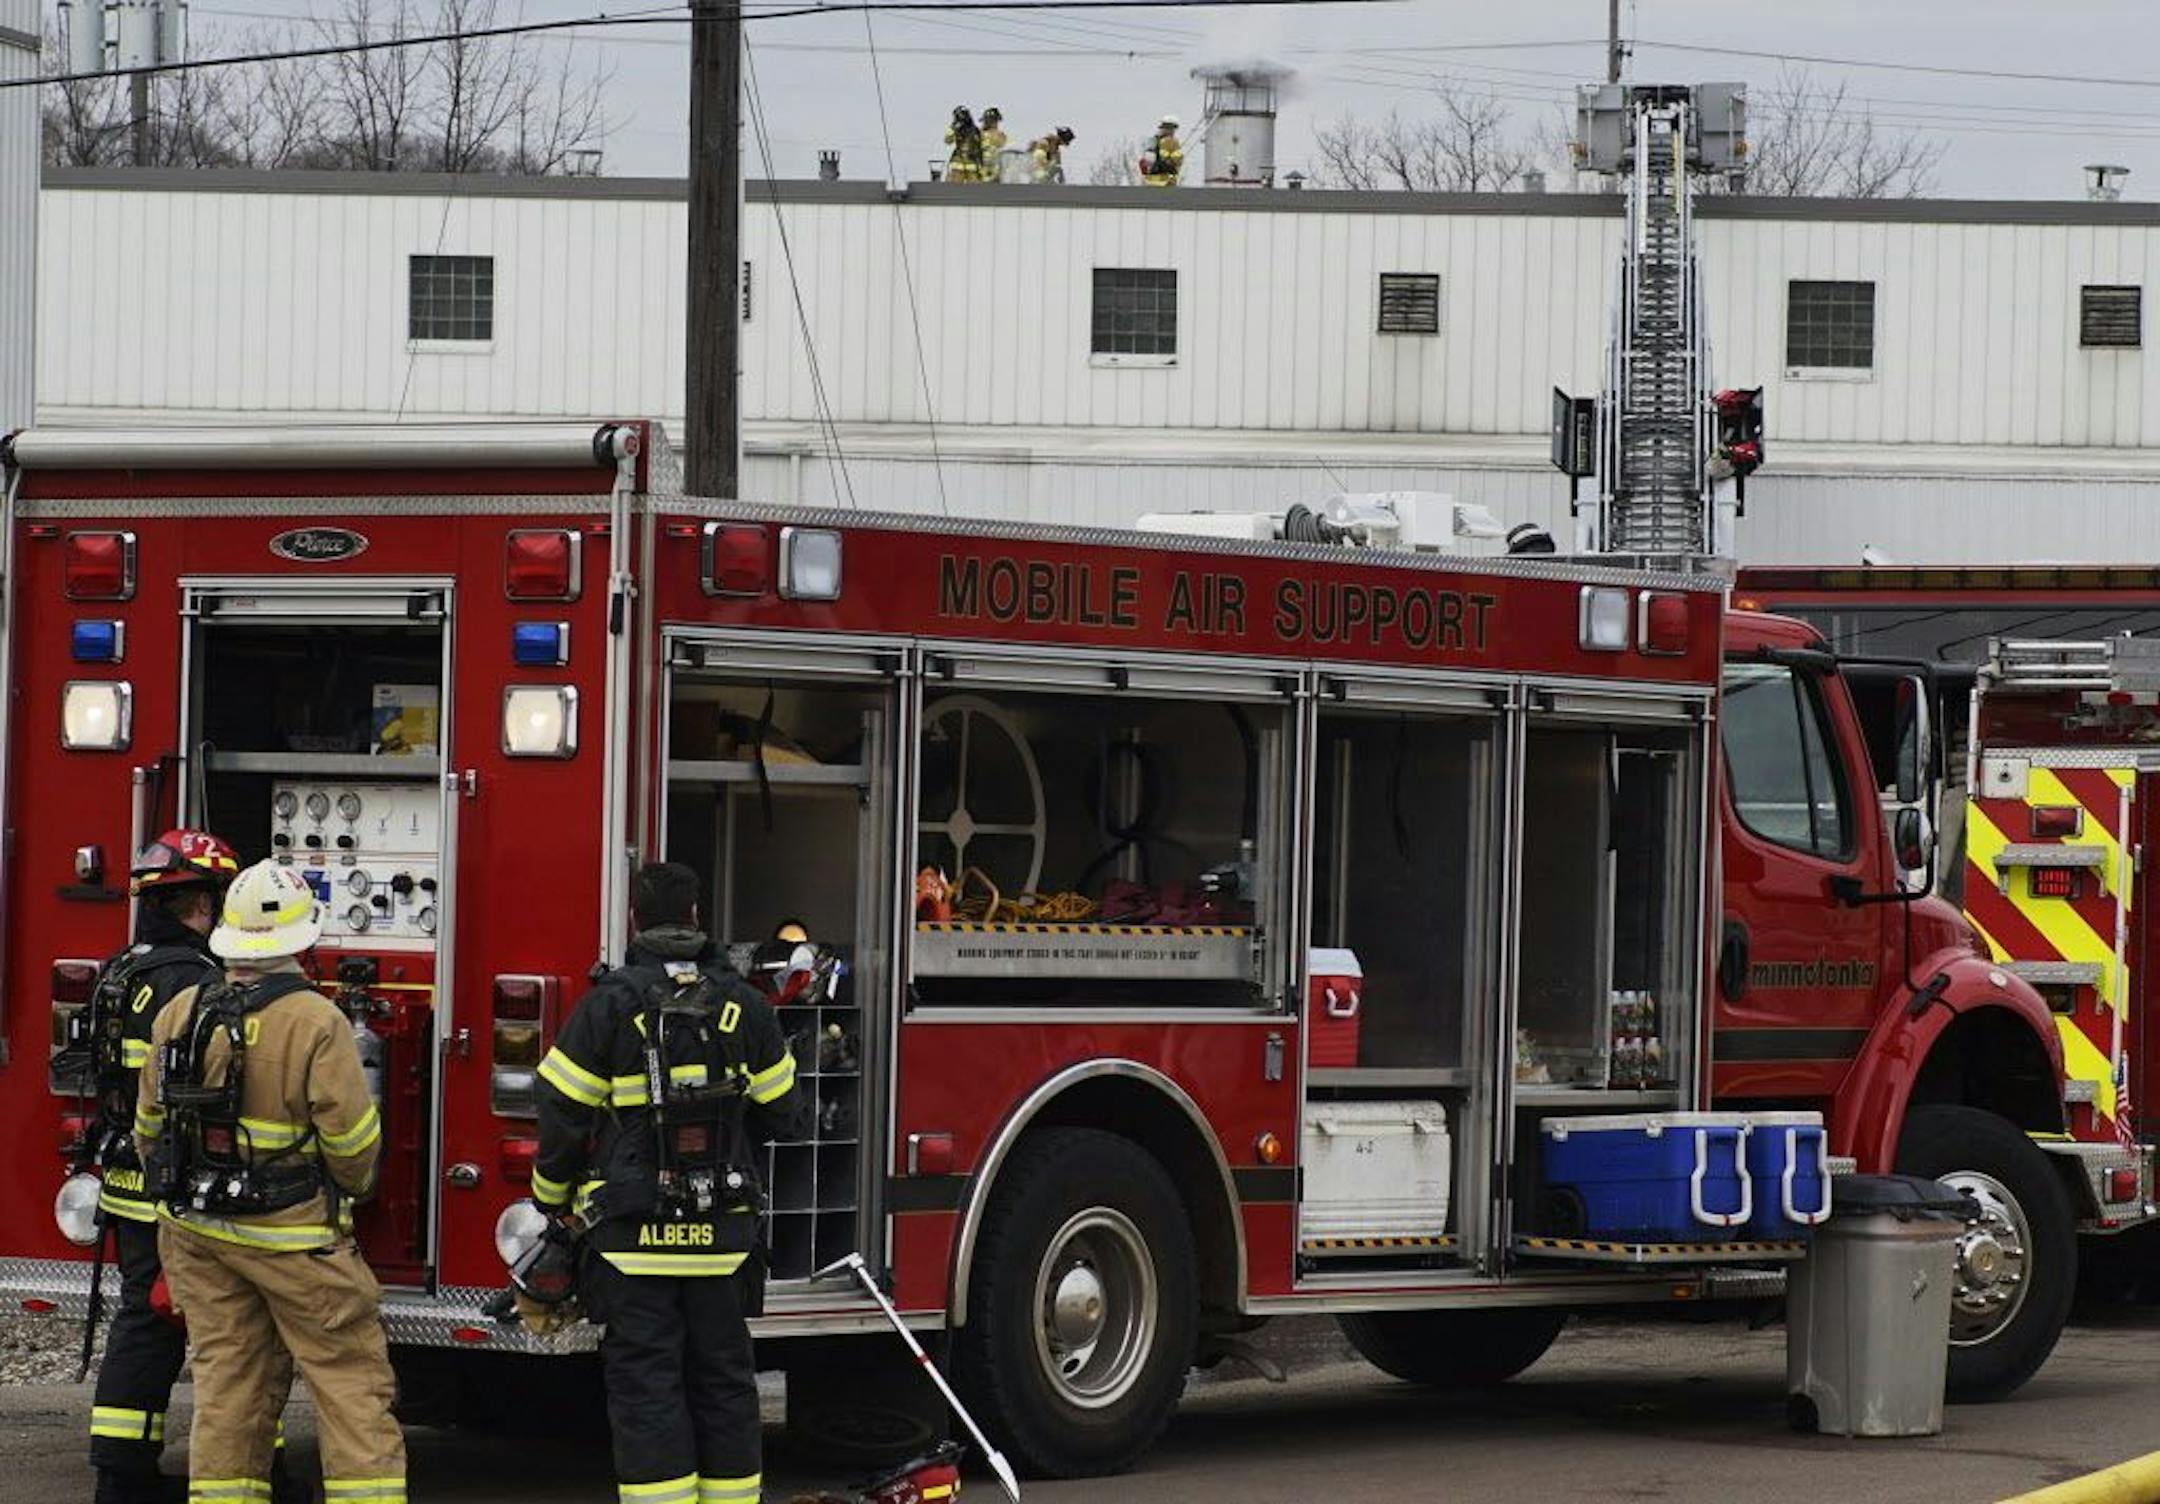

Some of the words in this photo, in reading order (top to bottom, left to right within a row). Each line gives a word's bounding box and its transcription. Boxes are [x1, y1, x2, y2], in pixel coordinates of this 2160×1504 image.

[938, 553, 1140, 630] MOBILE
[1163, 570, 1247, 636] AIR
[1274, 577, 1497, 653] SUPPORT
[638, 1222, 715, 1247] ALBERS
